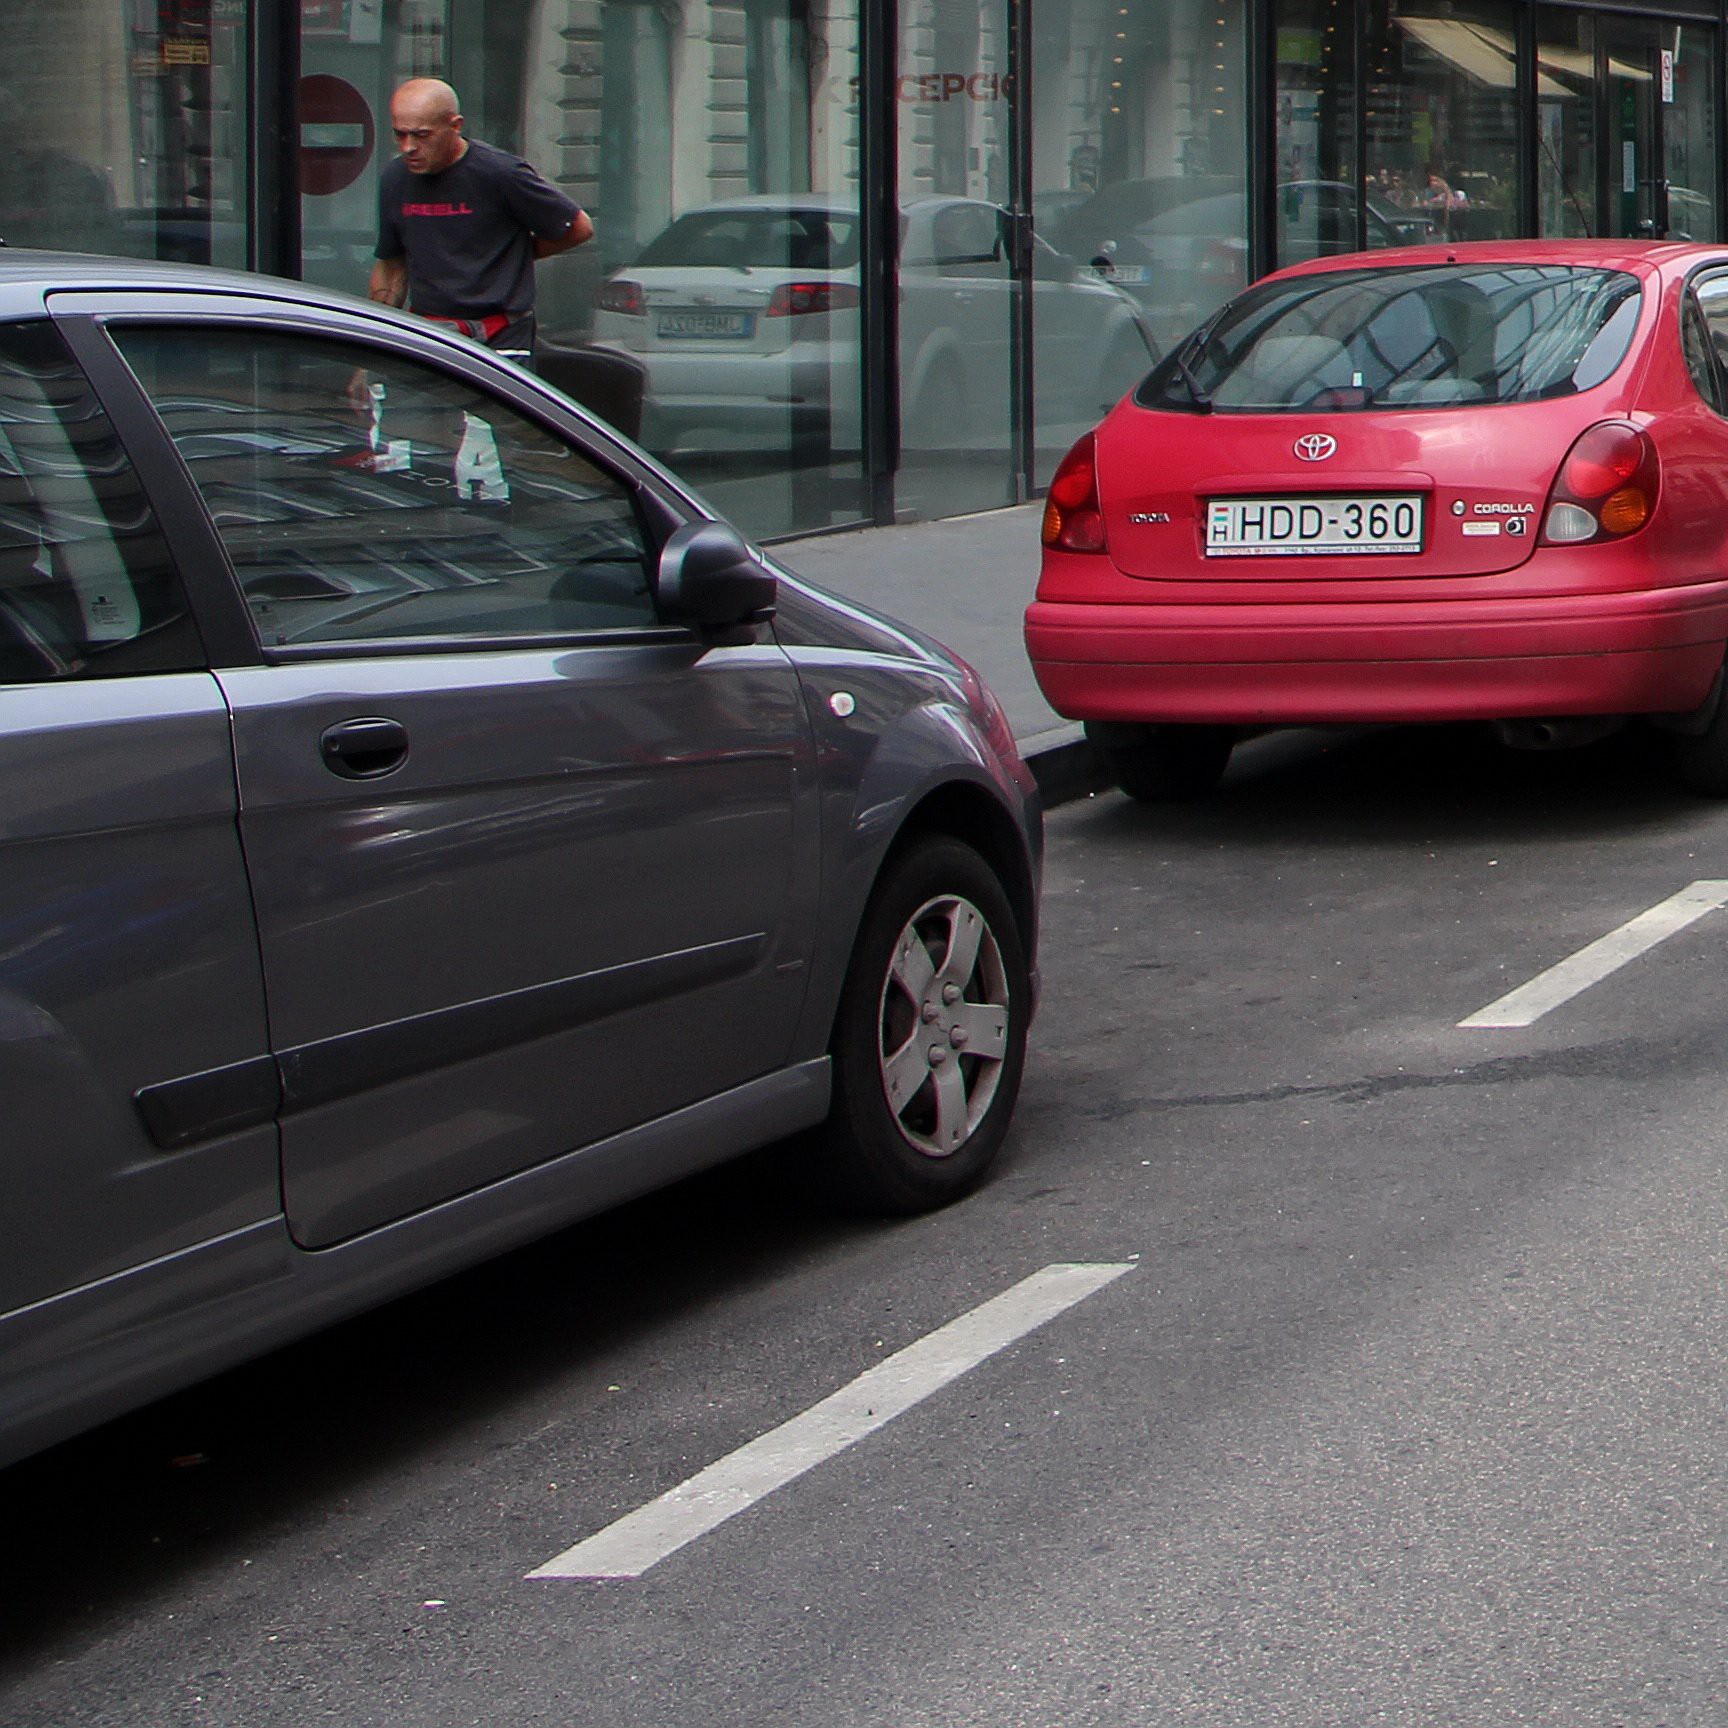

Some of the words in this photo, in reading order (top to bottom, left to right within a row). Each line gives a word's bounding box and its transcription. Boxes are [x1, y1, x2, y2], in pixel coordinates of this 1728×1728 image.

[849, 73, 1012, 104] CEPCI
[1473, 503, 1534, 514] COROLLA
[1240, 502, 1415, 540] HDD-360
[1213, 525, 1227, 541] H
